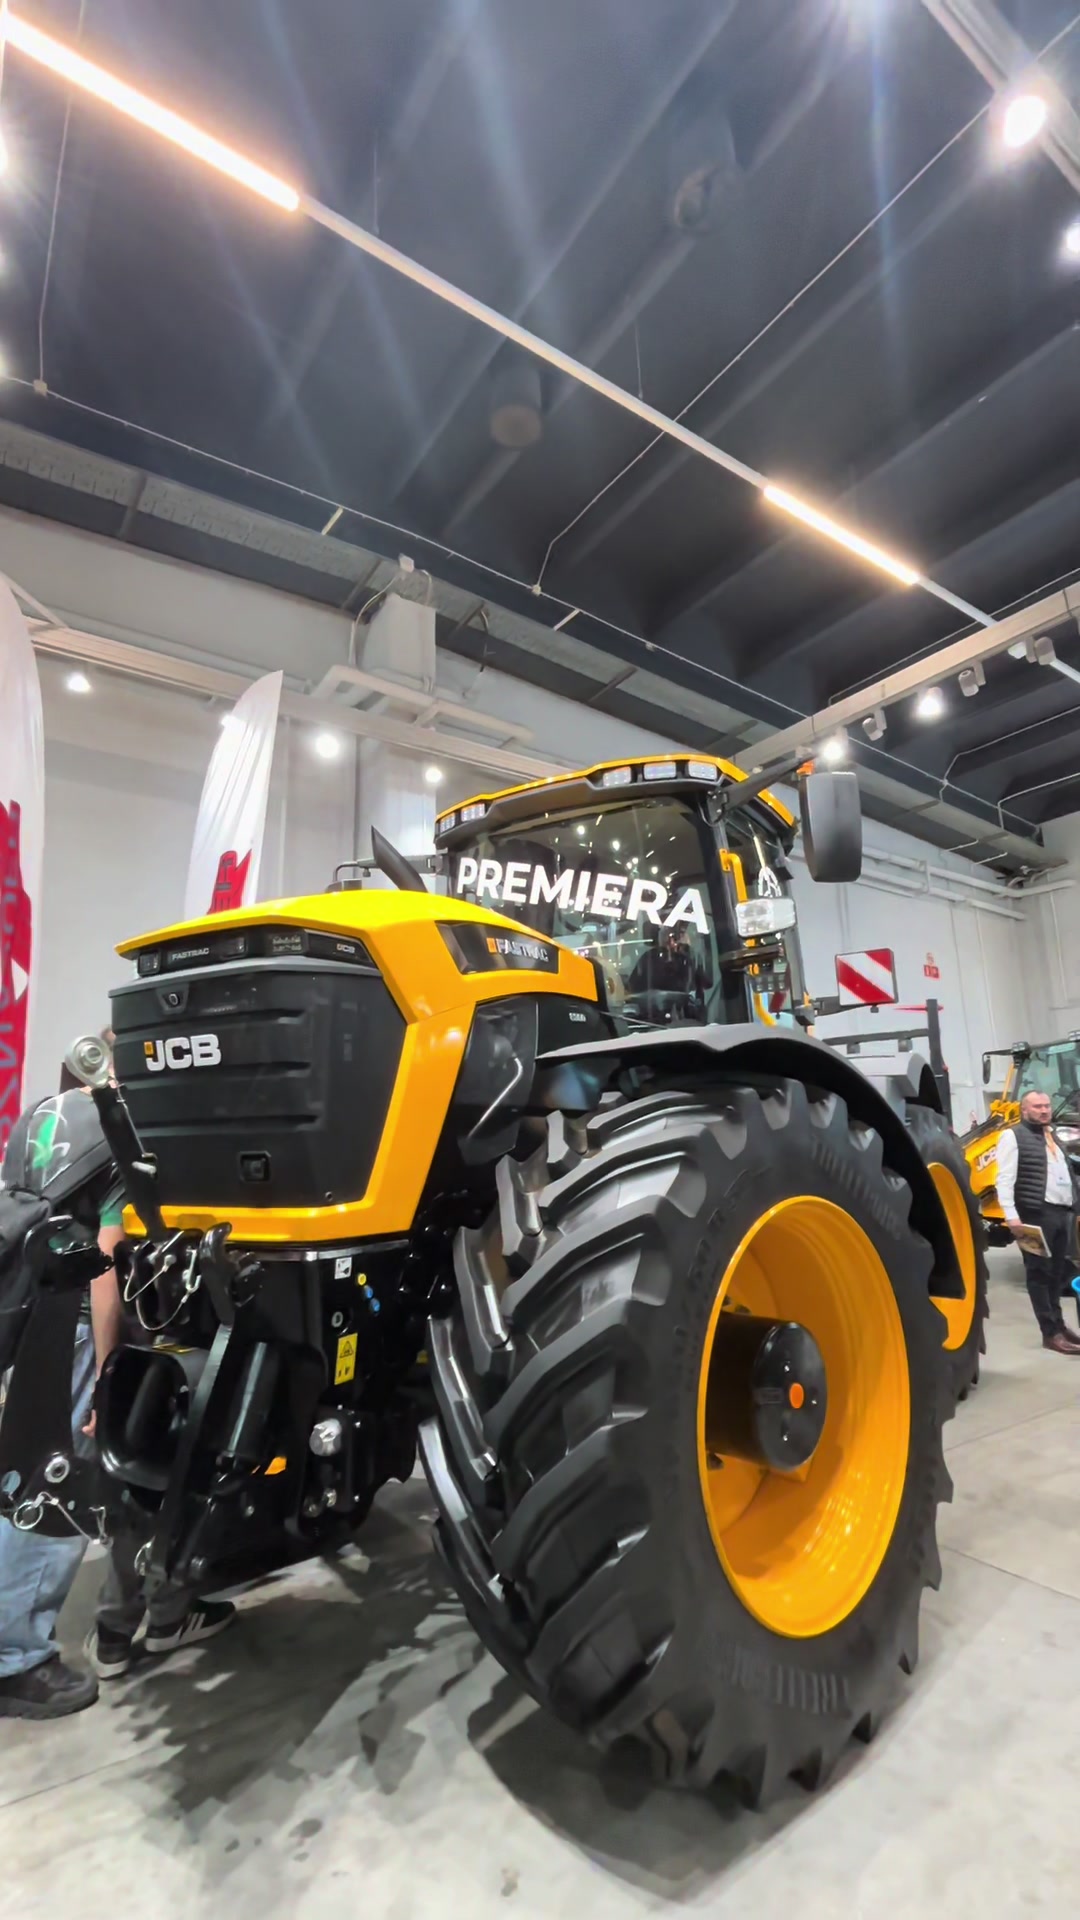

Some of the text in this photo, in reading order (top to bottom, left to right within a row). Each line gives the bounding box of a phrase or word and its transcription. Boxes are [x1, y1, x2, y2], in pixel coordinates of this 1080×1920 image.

[456, 857, 710, 935] PREMIERA
[171, 947, 210, 961] FASTRAC
[144, 1033, 222, 1071] JCB
